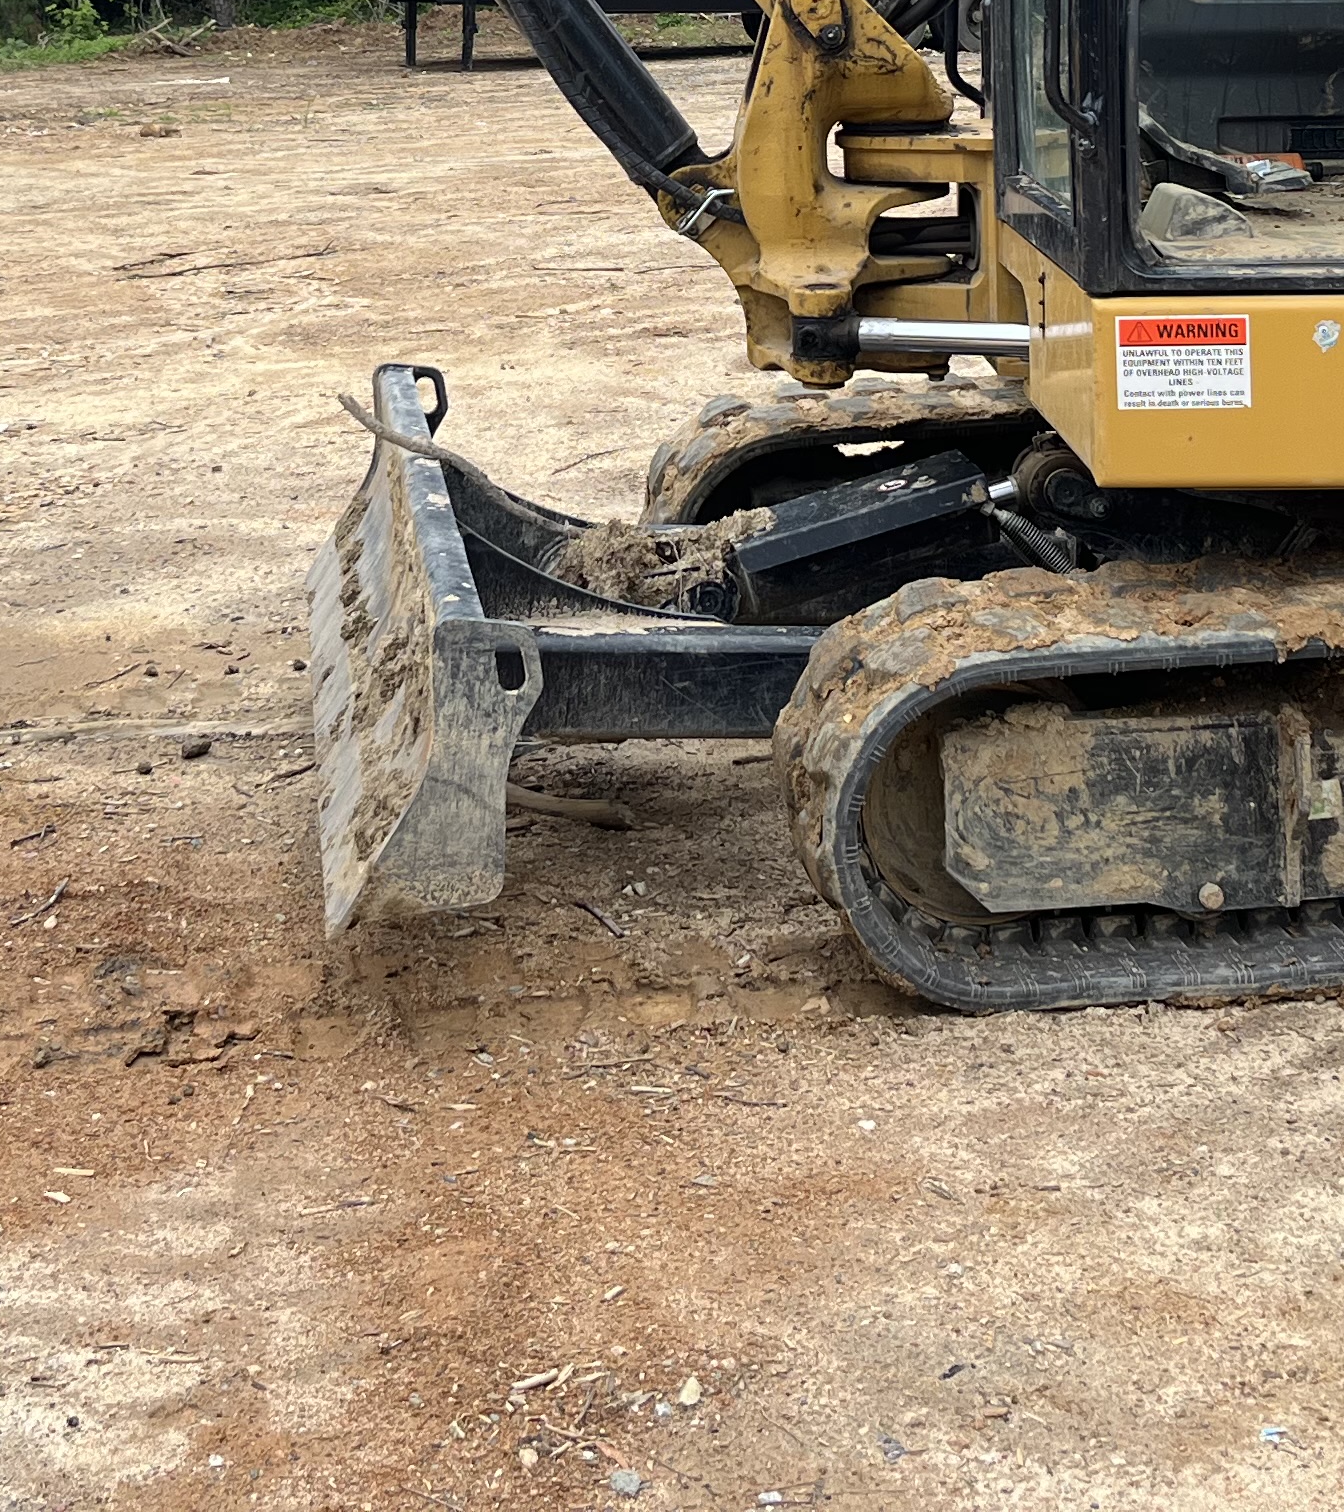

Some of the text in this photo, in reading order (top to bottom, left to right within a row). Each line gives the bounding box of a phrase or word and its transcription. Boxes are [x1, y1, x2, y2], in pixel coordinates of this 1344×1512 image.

[1157, 322, 1239, 339] WARNING
[1122, 348, 1244, 357] UNLAWFUL TO OPERATE THIS
[1122, 357, 1244, 367] EQUIPMENT WITHIN TEN FEET
[1123, 369, 1133, 377] OF
[1136, 368, 1181, 377] OVERHEAD
[1124, 389, 1155, 397] Contact
[1157, 389, 1176, 397] with
[1178, 390, 1205, 399] power
[1124, 399, 1146, 407] result
[1157, 399, 1179, 407] death
